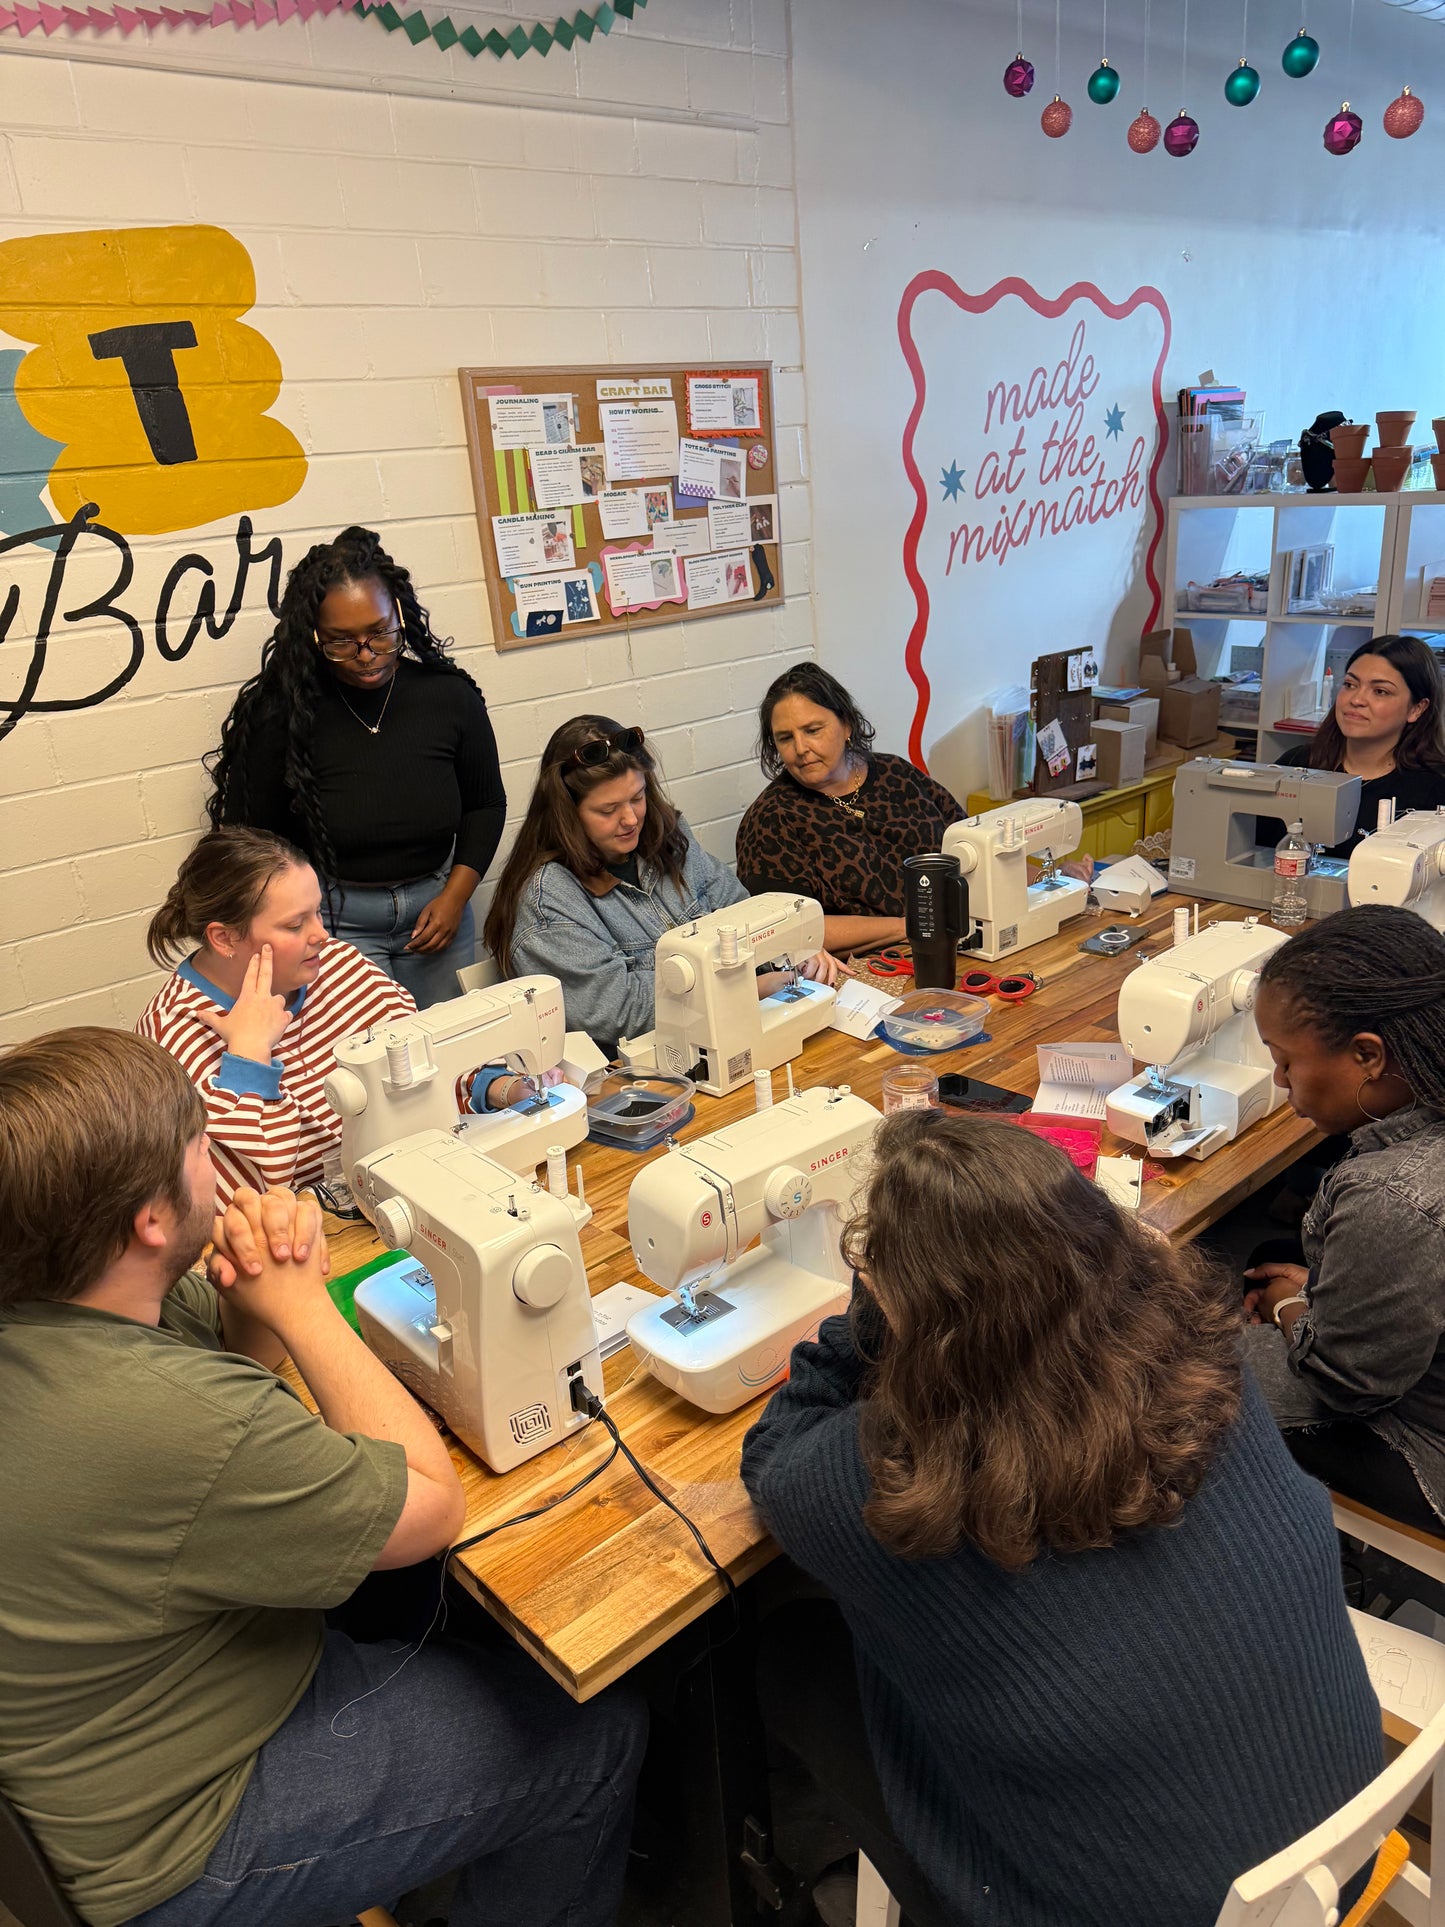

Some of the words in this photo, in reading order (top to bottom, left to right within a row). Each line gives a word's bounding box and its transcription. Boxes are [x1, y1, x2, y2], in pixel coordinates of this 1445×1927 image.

[984, 320, 1100, 433] made
[88, 320, 198, 465] T
[600, 386, 640, 396] CRAFT
[643, 385, 667, 395] BAR
[710, 447, 737, 457] PAINTING
[975, 426, 1026, 500] at
[1039, 401, 1100, 485] the
[946, 436, 1145, 576] mixmatch
[497, 516, 525, 525] CANDLE
[525, 513, 556, 522] MAKING
[751, 929, 776, 944] SINGER
[538, 1006, 558, 1020] SINGER
[810, 1147, 849, 1172] SINGER
[419, 1223, 447, 1250] SINGER
